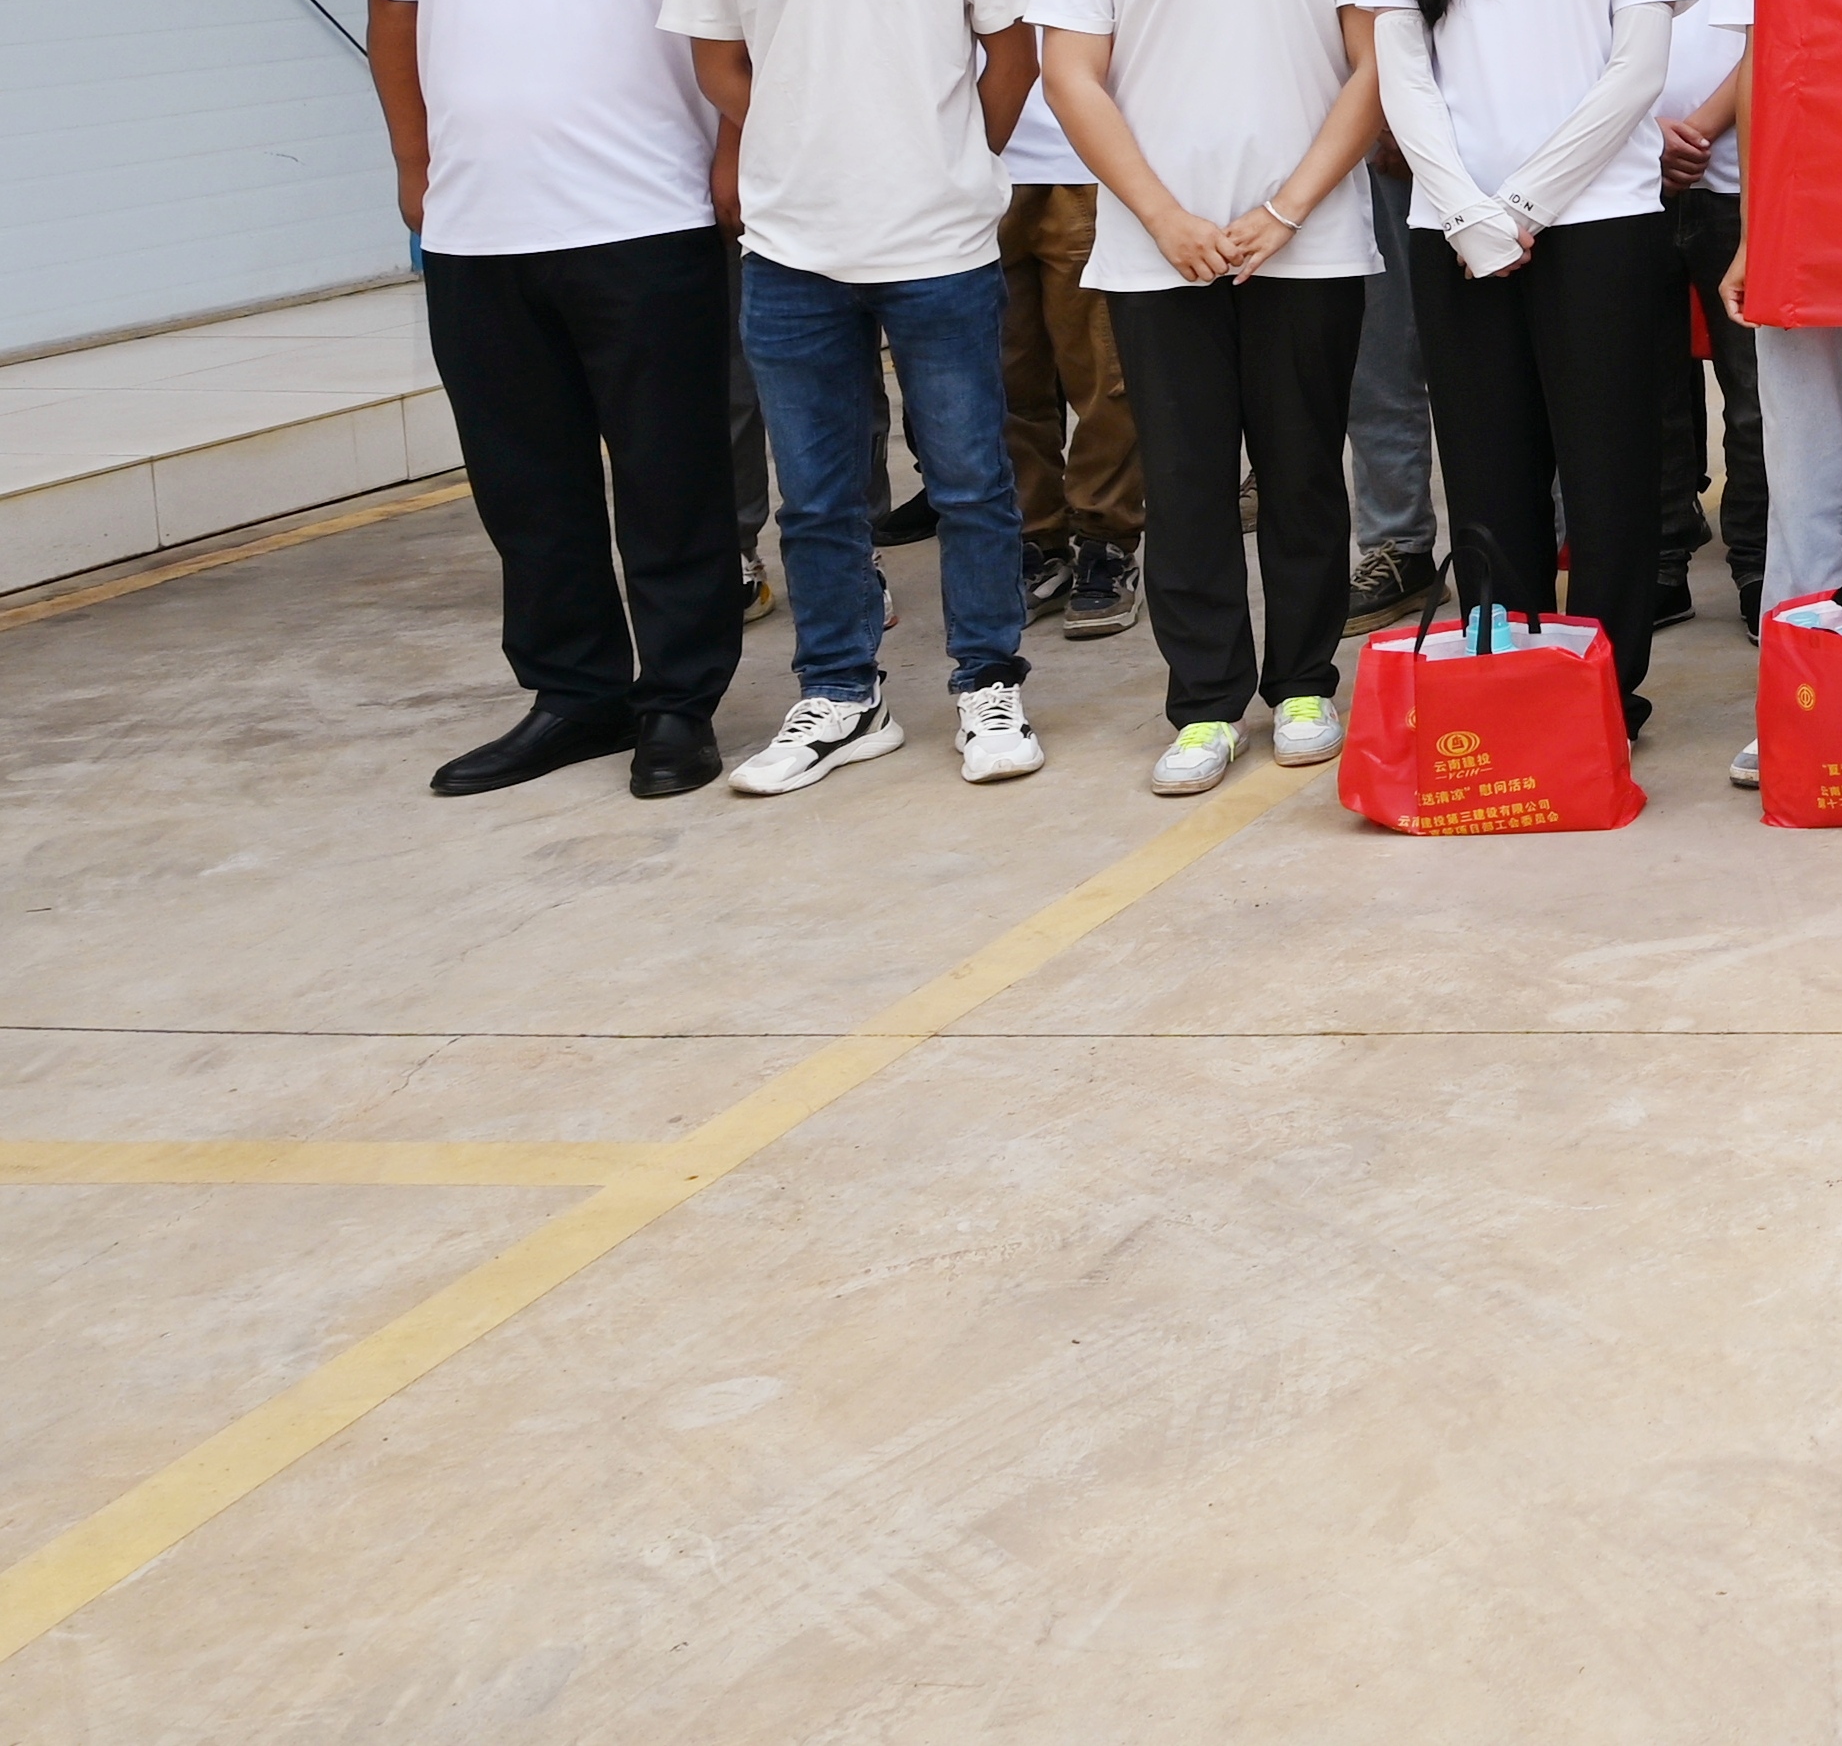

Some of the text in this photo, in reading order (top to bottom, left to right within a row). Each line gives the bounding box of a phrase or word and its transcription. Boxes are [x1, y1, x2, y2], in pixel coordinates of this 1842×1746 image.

[1434, 753, 1491, 773] 云南建投
[1414, 775, 1536, 807] “送清凉” 慰问活动
